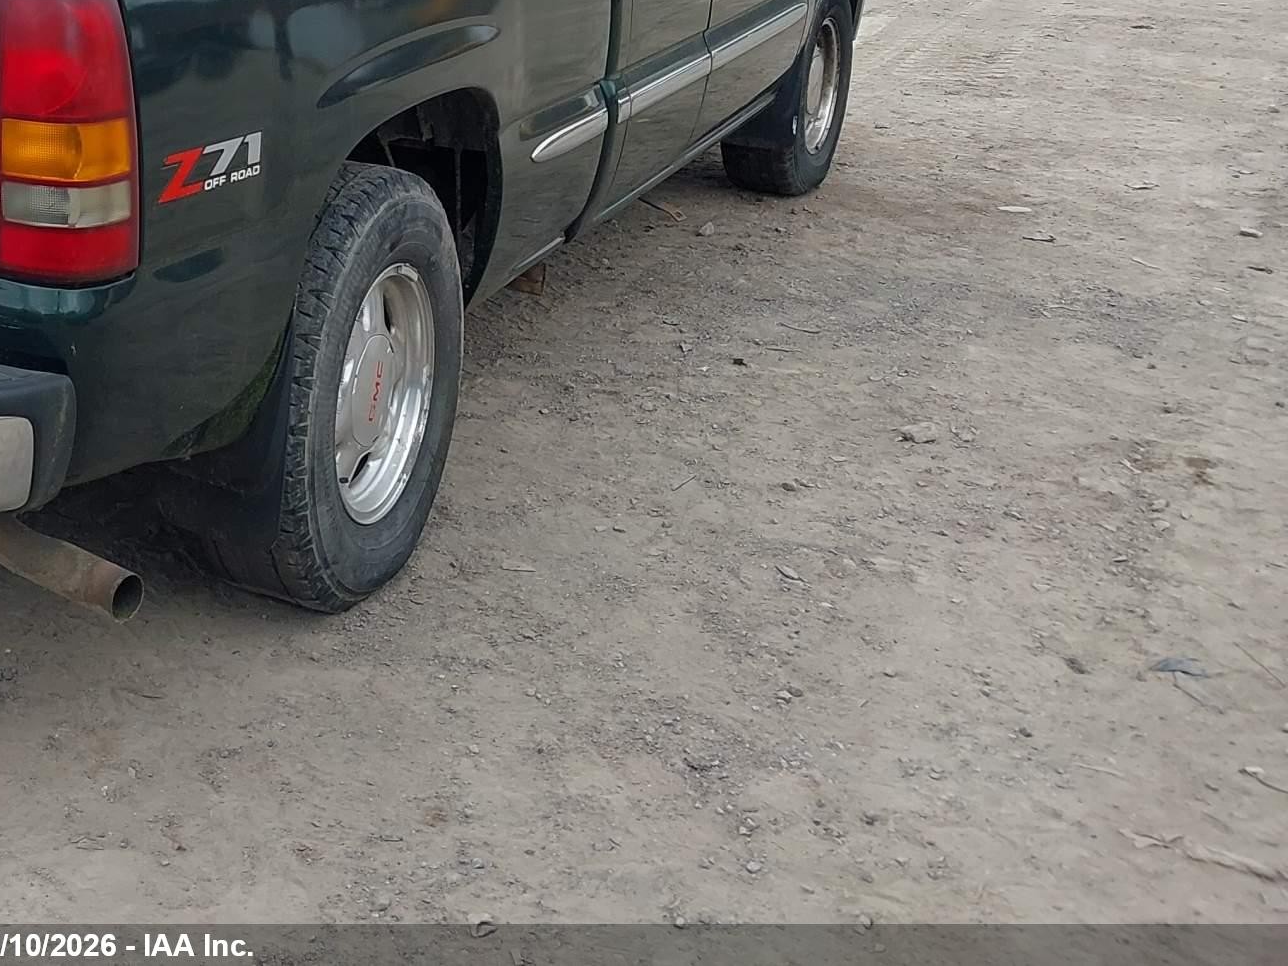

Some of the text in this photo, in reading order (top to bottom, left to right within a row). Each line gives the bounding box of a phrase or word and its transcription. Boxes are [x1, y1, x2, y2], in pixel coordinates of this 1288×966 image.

[158, 131, 262, 203] Z71
[204, 165, 261, 191] OFF ROAD
